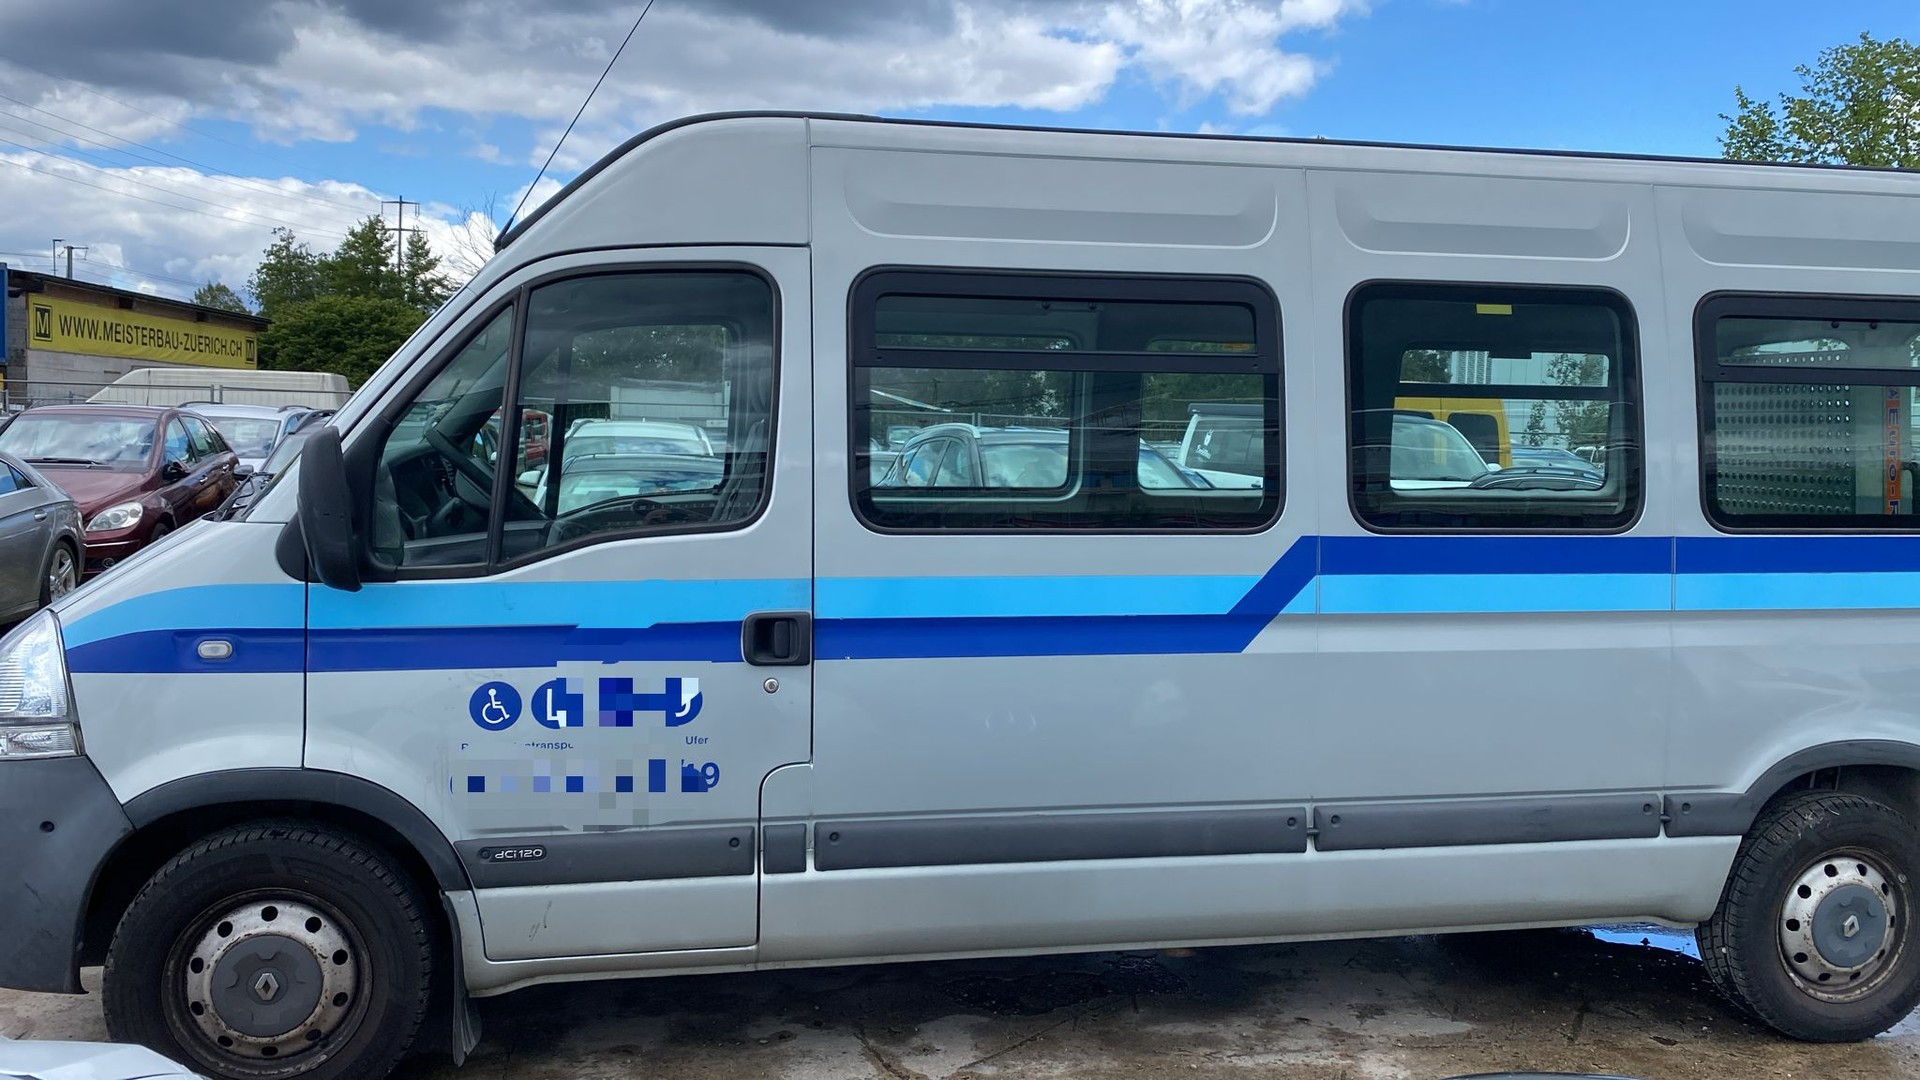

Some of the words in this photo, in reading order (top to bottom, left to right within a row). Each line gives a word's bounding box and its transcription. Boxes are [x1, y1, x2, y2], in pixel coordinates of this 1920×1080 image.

[35, 309, 50, 337] M
[58, 314, 243, 357] WWW.MEISTERBAU-ZUERICH.CH
[685, 735, 709, 745] Ufer
